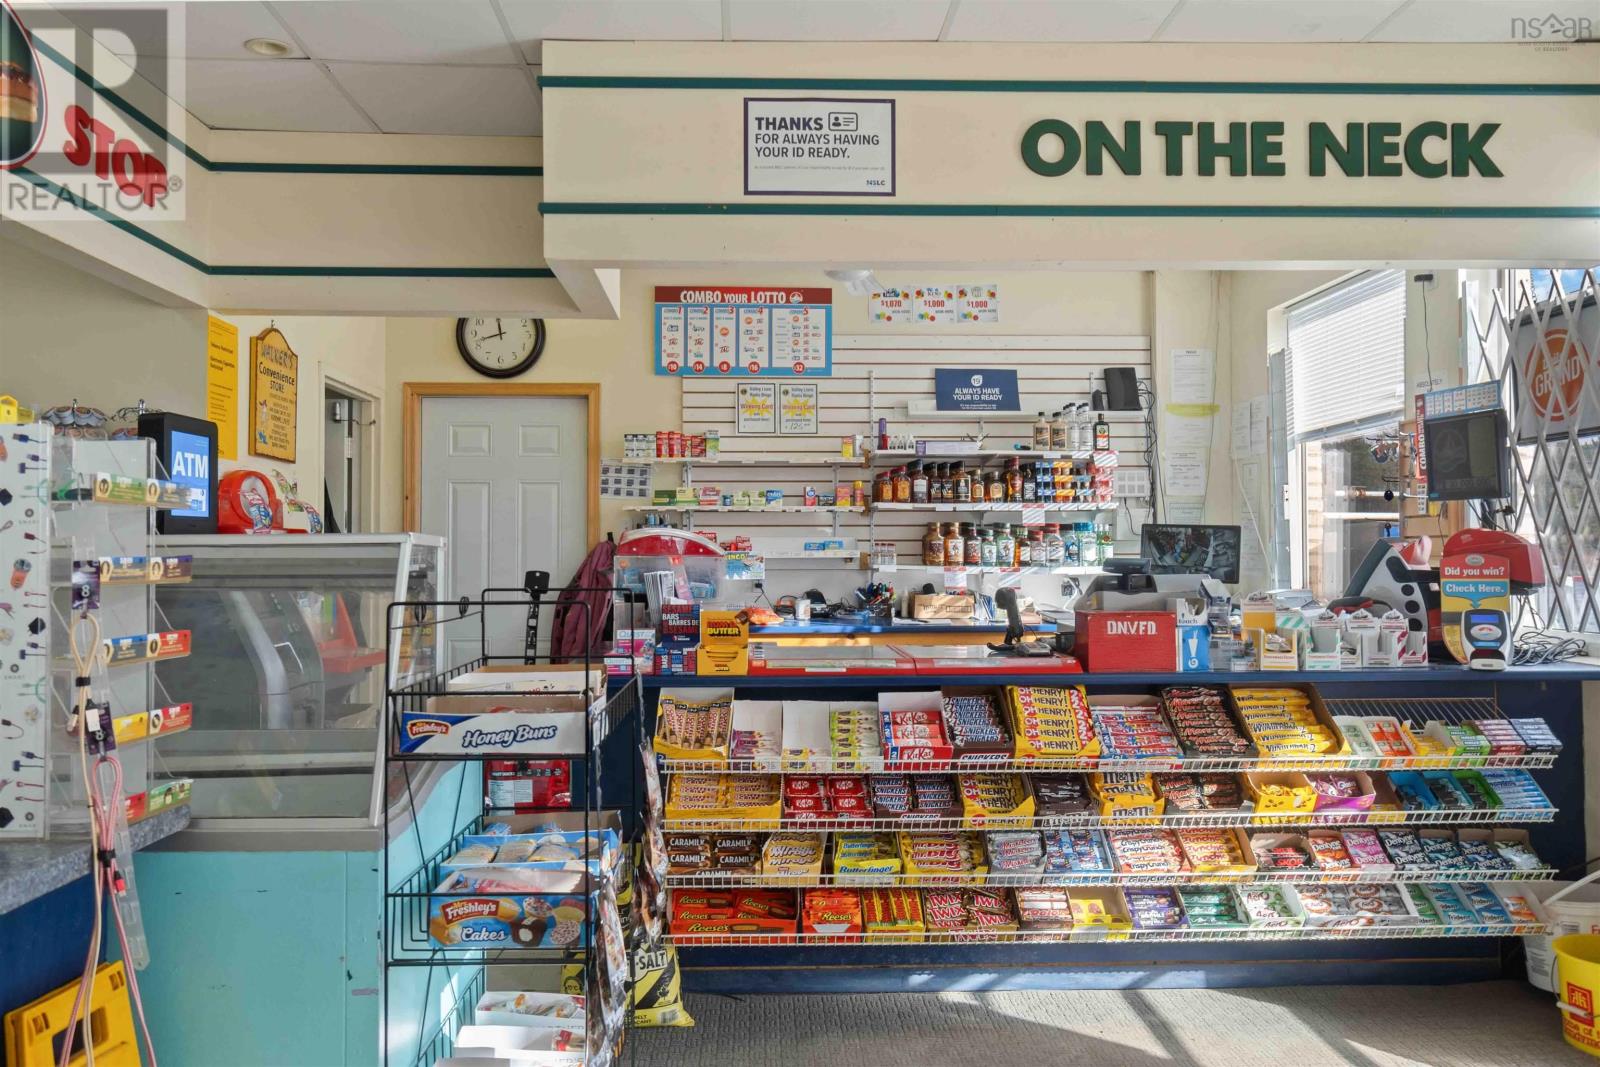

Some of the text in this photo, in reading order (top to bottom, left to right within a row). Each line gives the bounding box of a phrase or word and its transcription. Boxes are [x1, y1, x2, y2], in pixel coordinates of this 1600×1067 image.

[755, 117, 823, 130] THANKS
[755, 133, 880, 145] FOR ALWAYS HAVING
[755, 147, 850, 158] YOUR ID READY.
[1021, 118, 1504, 178] ON THE NECK
[62, 104, 168, 207] STOP
[680, 290, 786, 304] COMBO YOUR LOTTO
[258, 361, 295, 386] Convenience
[1536, 356, 1580, 396] GRND
[269, 379, 285, 394] STORE
[172, 451, 208, 479] ATM
[1444, 567, 1505, 577] Did you win?
[1446, 584, 1504, 593] Check Here.
[1020, 695, 1032, 703] OH
[1023, 706, 1036, 715] OH
[1025, 718, 1038, 726] OH
[462, 724, 558, 748] Honey Buns
[964, 727, 999, 735] SNICKERS
[1030, 741, 1042, 749] OH
[876, 787, 905, 795] SNICKERS
[670, 838, 705, 846] CARAMILK
[717, 839, 752, 847] CARAMILK
[670, 855, 706, 863] CARAMILK
[720, 856, 755, 864] CARAMILK
[929, 894, 962, 908] TWIX
[973, 895, 1006, 908] TWIX
[446, 902, 497, 920] Freshley's
[680, 911, 708, 920] Reese's
[821, 911, 852, 921] Reese's
[929, 907, 966, 920] TWIX
[688, 923, 729, 932] Reese's
[461, 927, 506, 942] Cakes
[640, 951, 666, 970] SALT
